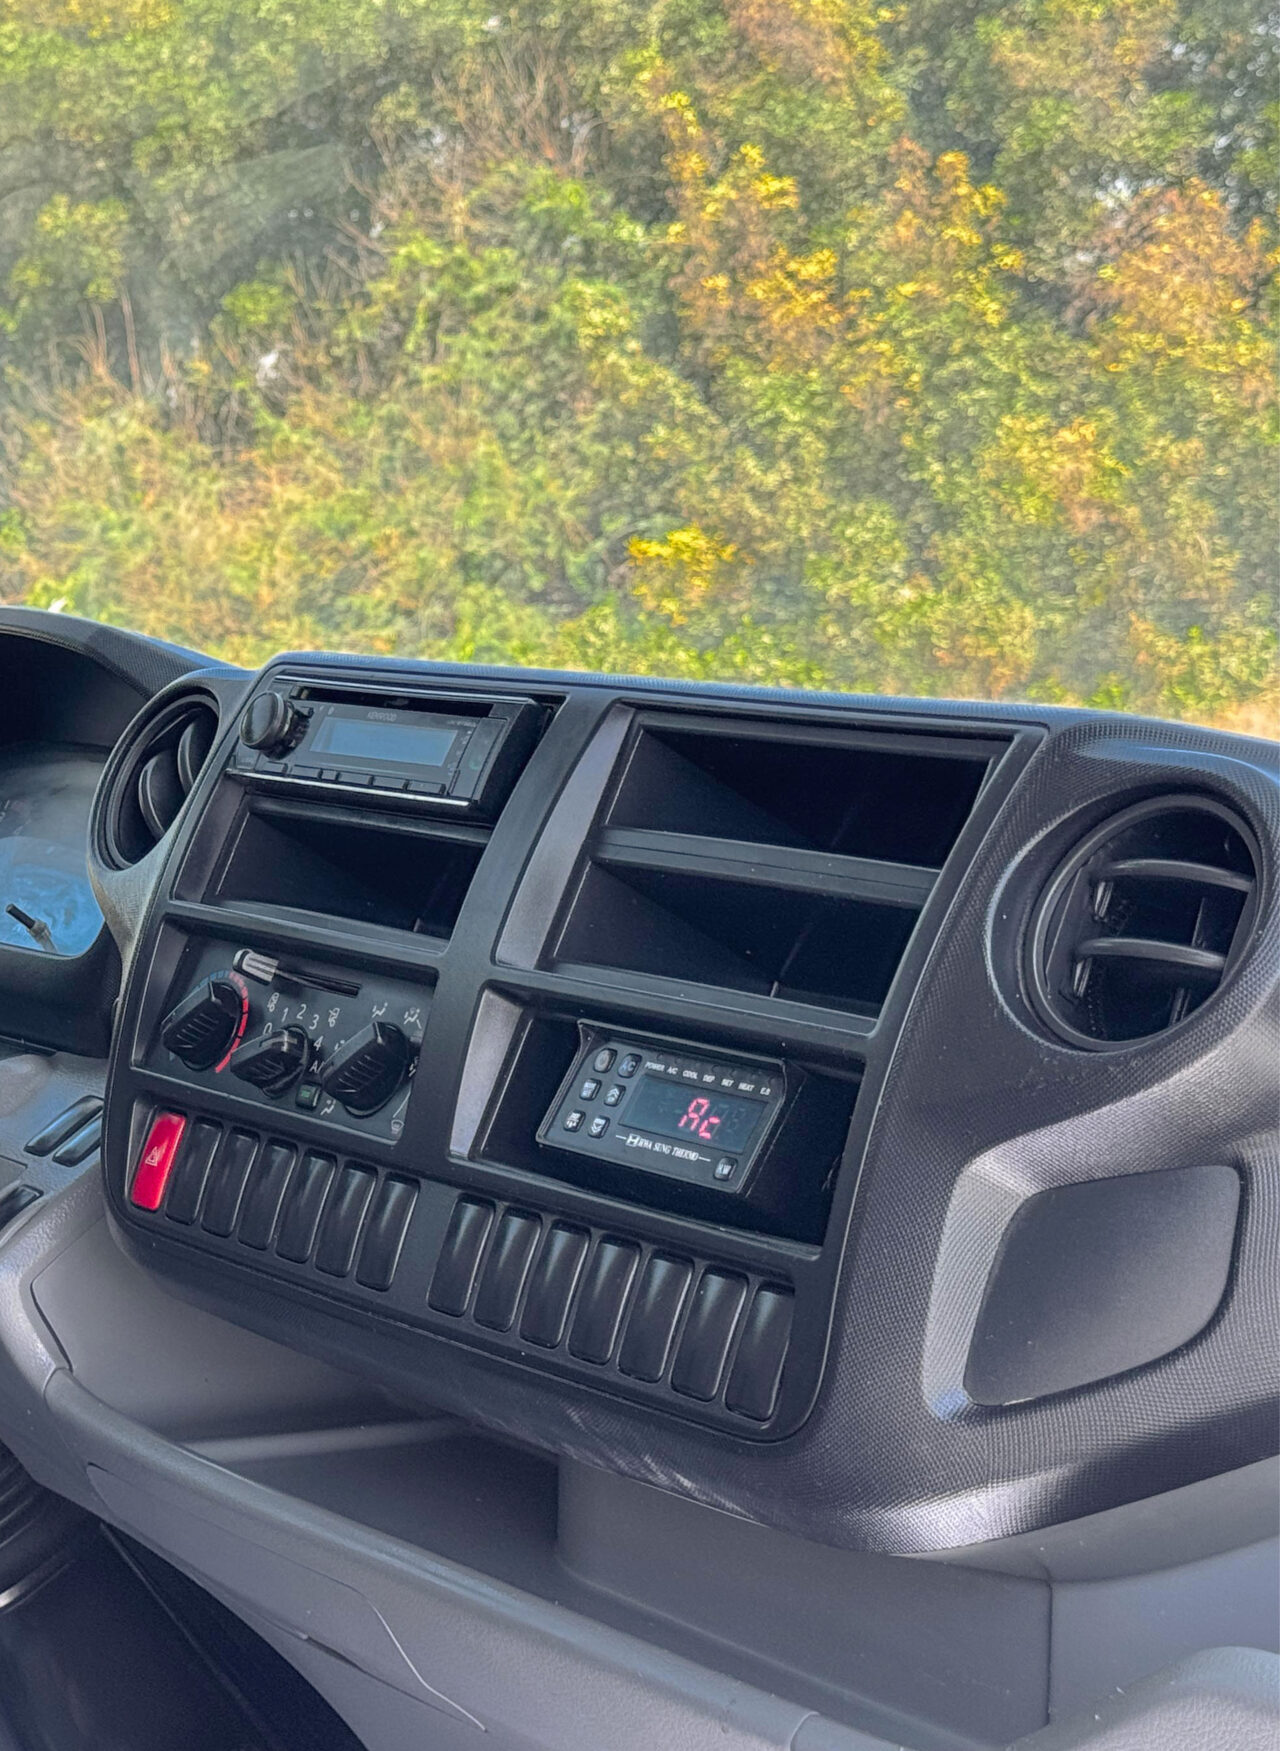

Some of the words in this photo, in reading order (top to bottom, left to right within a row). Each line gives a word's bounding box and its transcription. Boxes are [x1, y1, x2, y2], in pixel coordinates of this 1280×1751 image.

[281, 1007, 288, 1022] 1
[296, 1003, 306, 1019] 2
[309, 1014, 319, 1029] 3
[313, 1036, 323, 1051] 4
[652, 1142, 672, 1155] SUNG
[671, 1146, 699, 1161] THERMO
